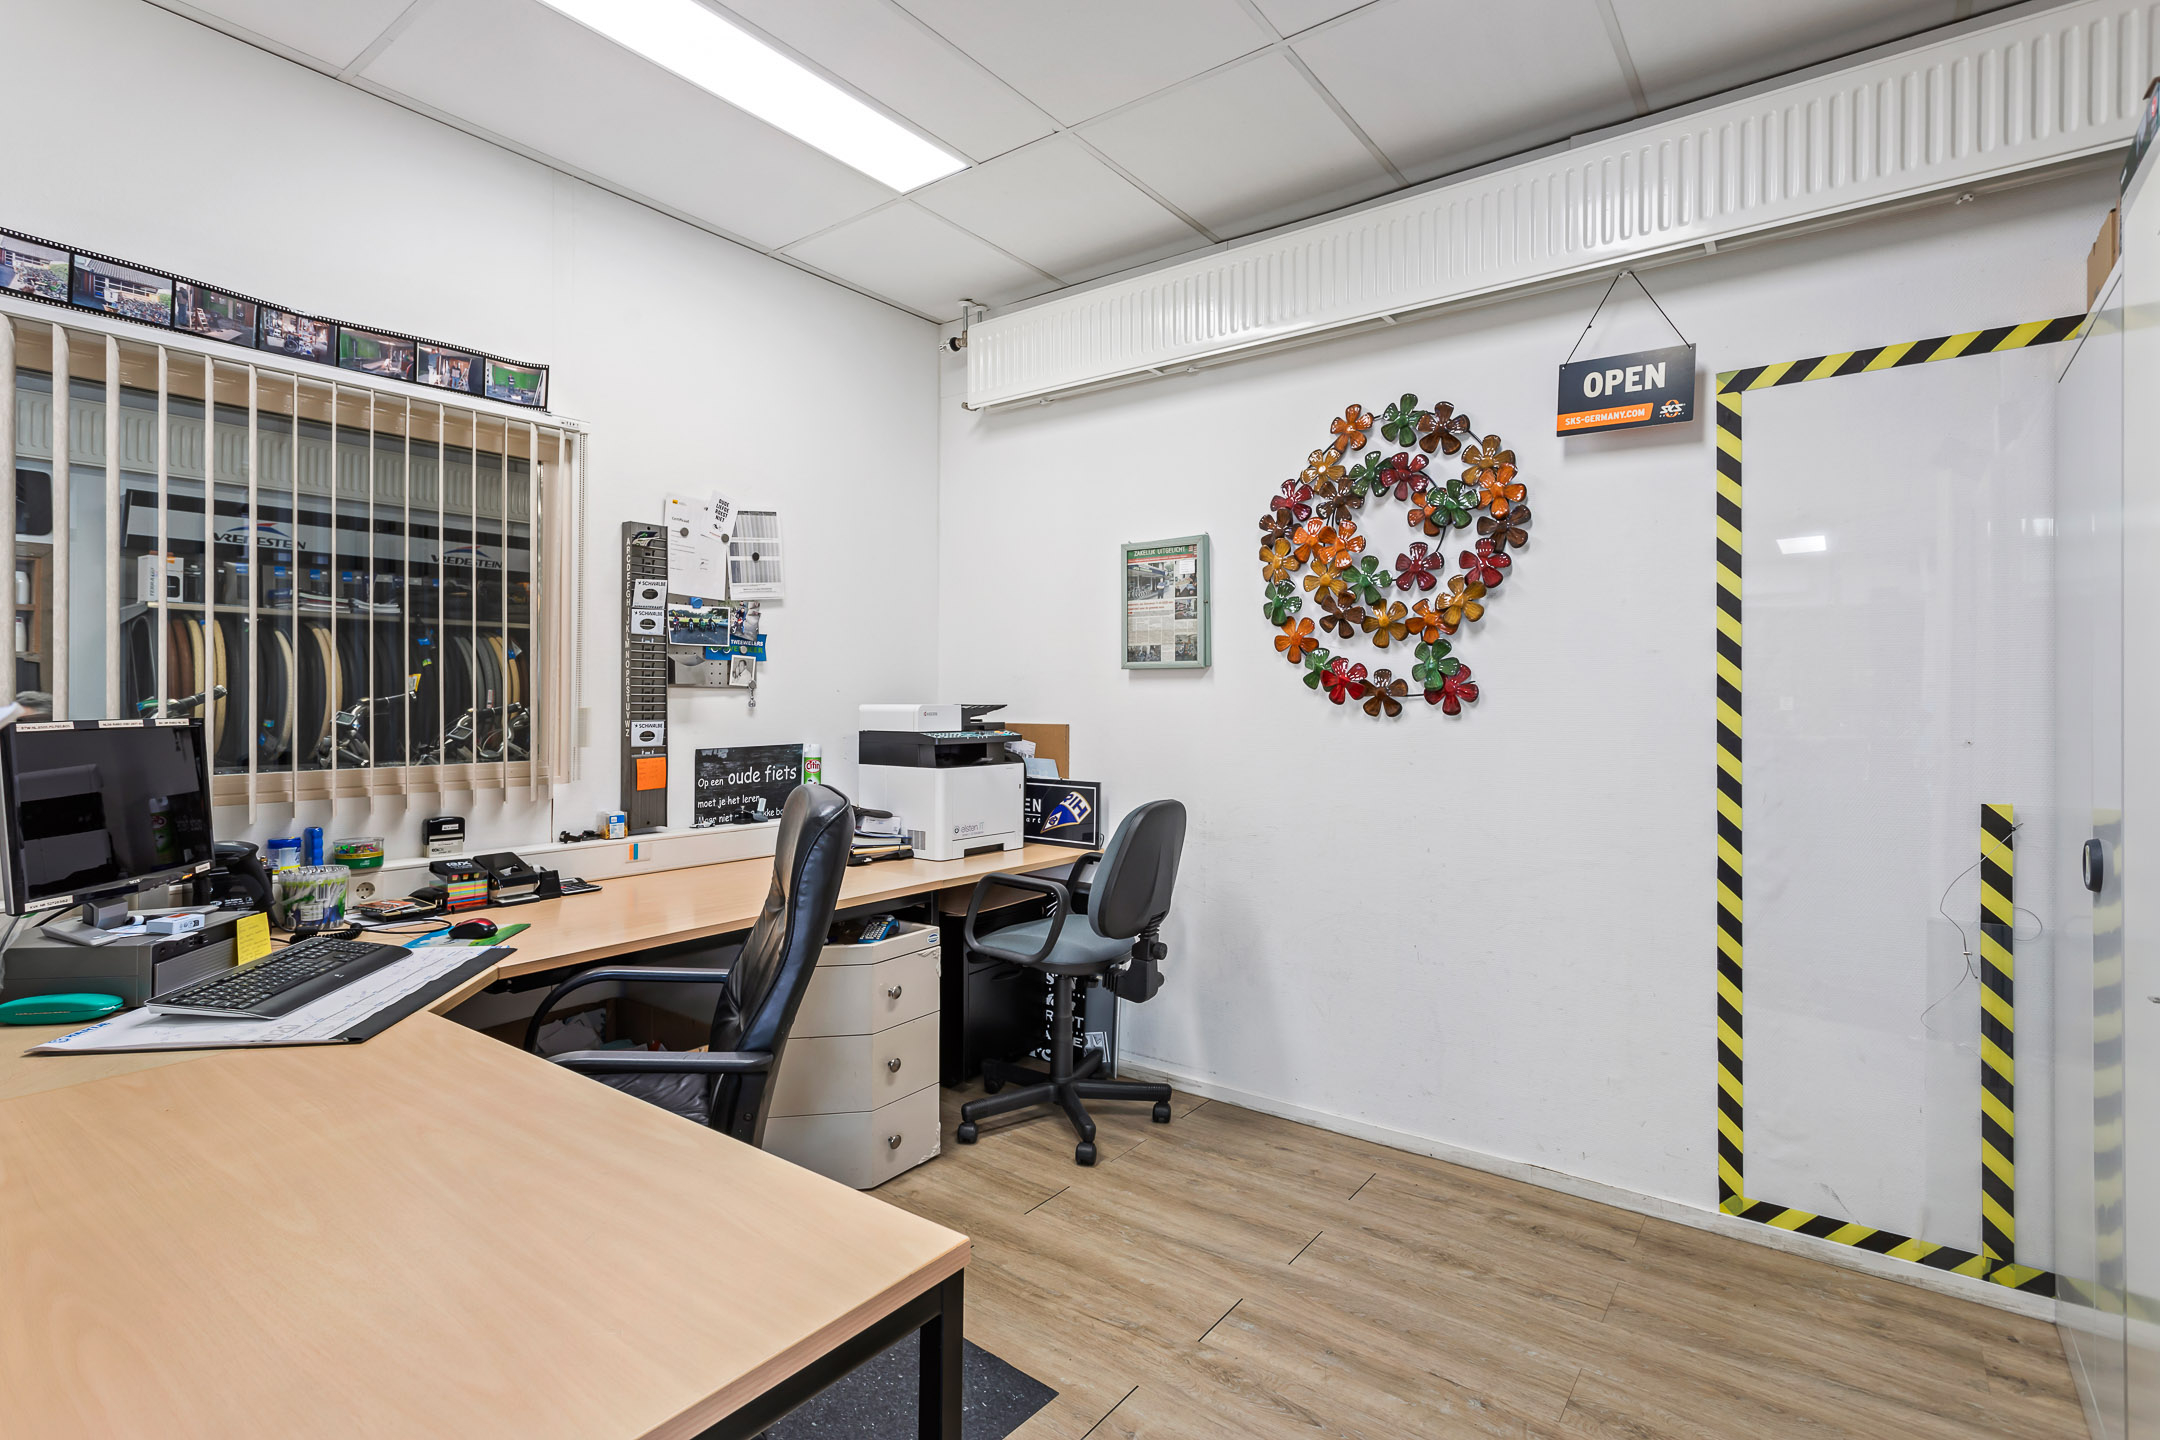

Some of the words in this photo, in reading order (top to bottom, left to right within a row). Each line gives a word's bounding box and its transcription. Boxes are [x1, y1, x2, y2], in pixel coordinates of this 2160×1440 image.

[1583, 361, 1666, 398] OPEN
[1565, 408, 1645, 426] SKS-GERMANY.COM
[697, 778, 709, 789] Op
[711, 778, 724, 787] een
[727, 766, 761, 785] oude
[765, 764, 797, 783] fiets
[697, 799, 717, 809] moet
[717, 798, 726, 809] je
[727, 795, 741, 805] het
[718, 813, 733, 823] niet
